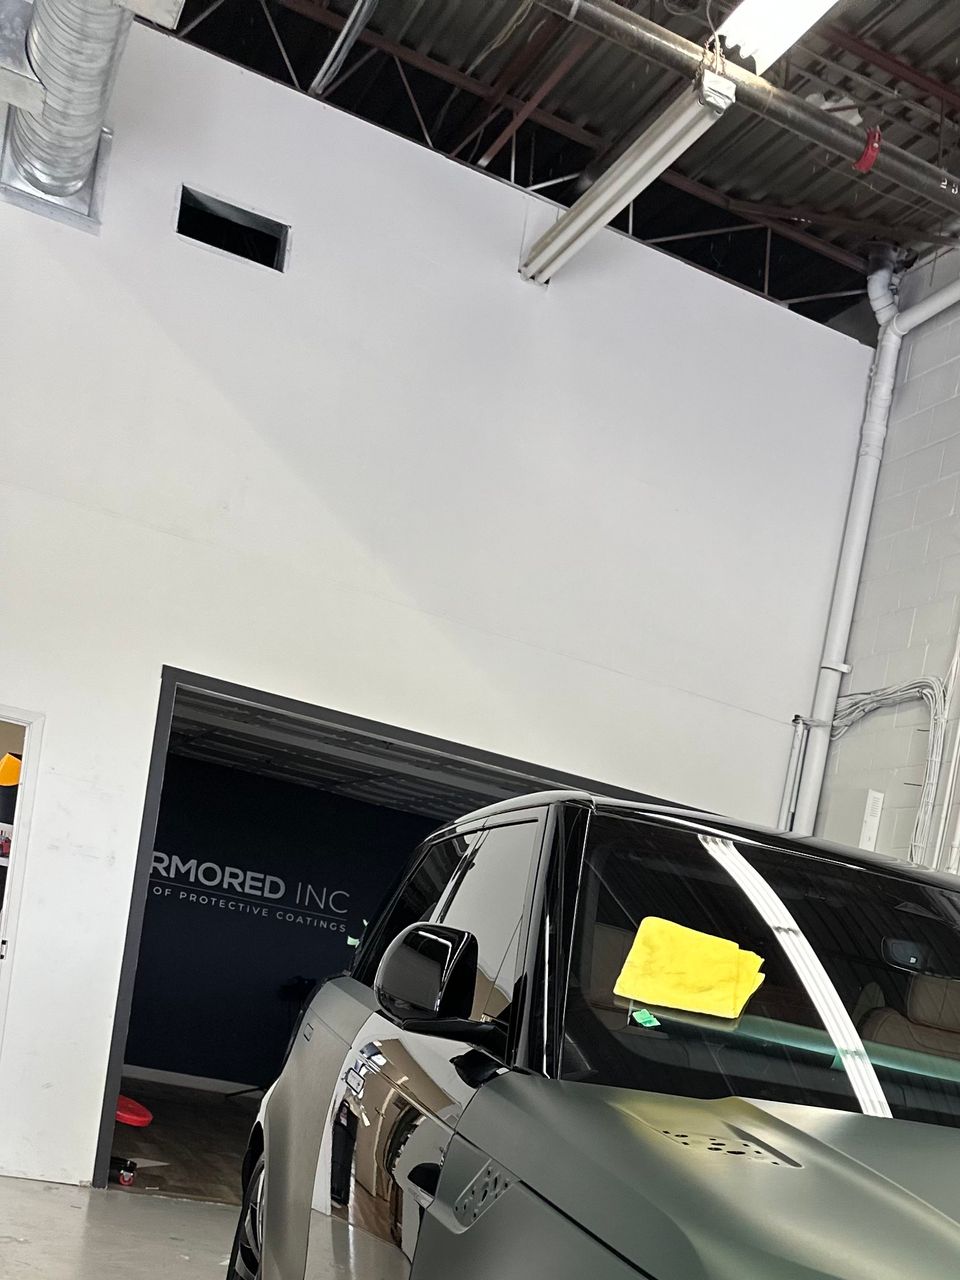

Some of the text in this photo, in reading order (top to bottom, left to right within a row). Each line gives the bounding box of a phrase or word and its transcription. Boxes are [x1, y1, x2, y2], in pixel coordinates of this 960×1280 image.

[153, 886, 347, 933] OF PROTECTIVE COATINGS
[296, 881, 350, 914] INC
